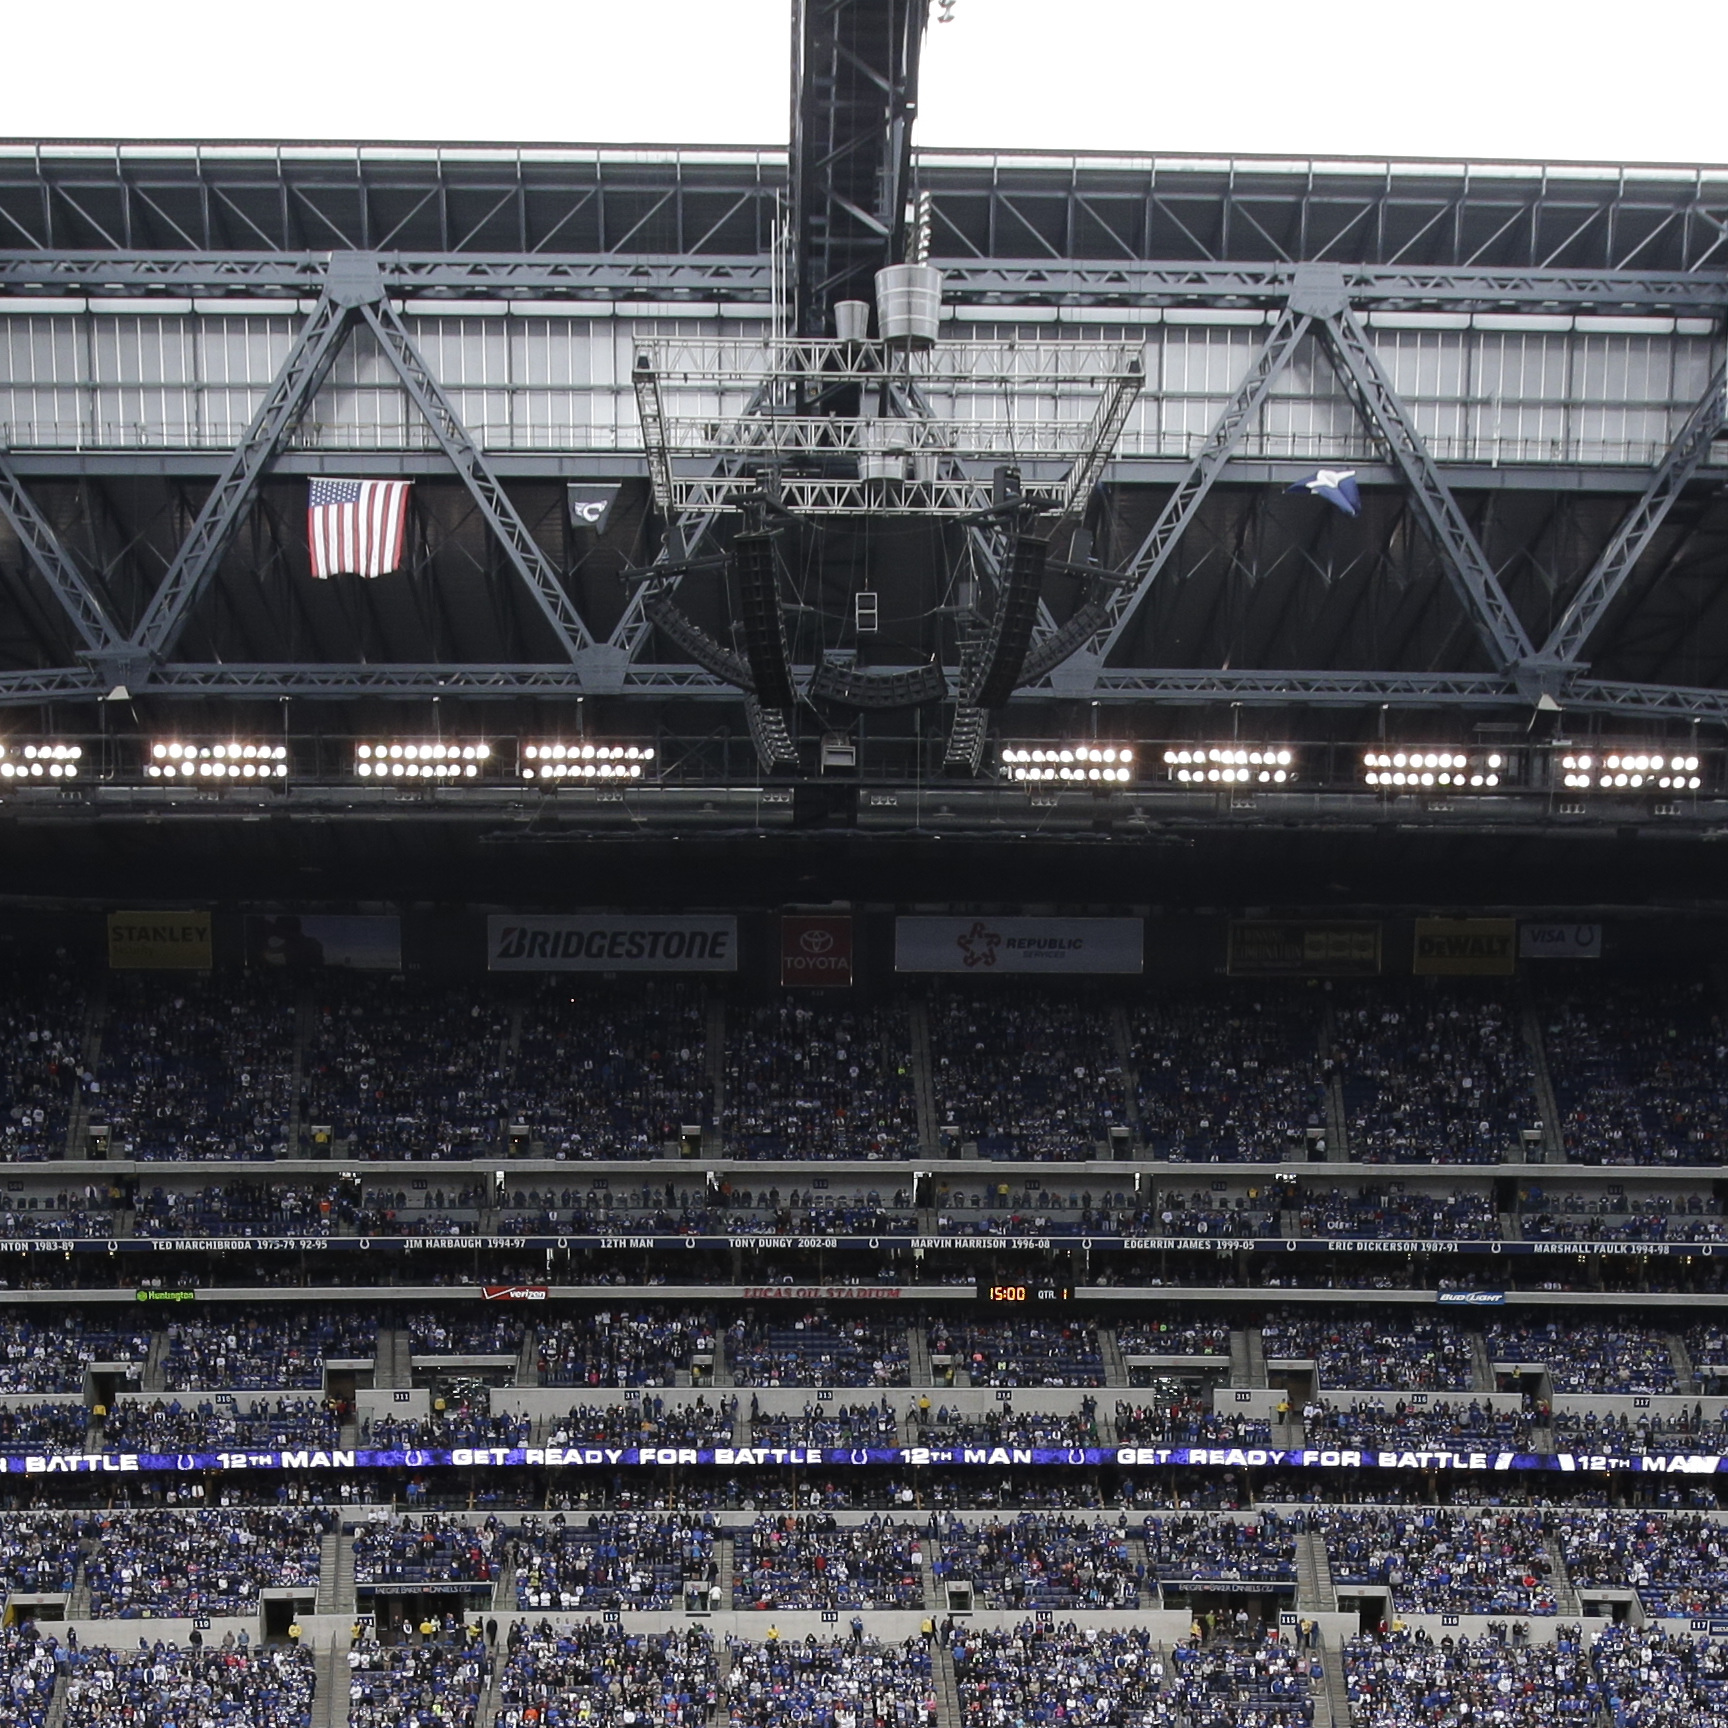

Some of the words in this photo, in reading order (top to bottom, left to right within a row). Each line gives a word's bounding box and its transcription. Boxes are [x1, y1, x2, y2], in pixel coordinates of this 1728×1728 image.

[112, 925, 208, 943] STANLEY
[1530, 929, 1566, 943] VISA
[496, 927, 729, 959] BRIDGESTONE
[1006, 938, 1084, 950] REPUBLIC
[784, 956, 849, 970] TOYOTA
[152, 1240, 172, 1250] TED
[175, 1240, 251, 1250] MARCHIBRODA
[404, 1239, 422, 1248] JIM
[425, 1239, 481, 1248] HARBAUGH
[629, 1239, 654, 1248] MAN
[729, 1239, 755, 1249] TONY
[758, 1239, 792, 1249] DUNGY
[911, 1239, 950, 1249] MARVIN
[954, 1239, 1006, 1249] HARRISON
[1124, 1240, 1175, 1250] EDGERRIN
[1178, 1240, 1211, 1250] JAMES
[1328, 1241, 1352, 1251] ERIC
[1355, 1241, 1417, 1252] DICKERSON
[1534, 1243, 1591, 1254] MARSHALL
[1594, 1244, 1627, 1255] FAULK
[148, 1290, 195, 1302] Huntington
[510, 1289, 546, 1300] verizon
[743, 1287, 792, 1298] LUCAS
[795, 1287, 823, 1298] OIL
[826, 1287, 901, 1298] STADIUM
[989, 1286, 1026, 1301] 15:00
[26, 1452, 138, 1472] BATTLE
[217, 1453, 272, 1468] 12TH
[281, 1451, 354, 1468] MAN
[452, 1448, 511, 1465] GET
[526, 1448, 622, 1465] READY
[640, 1449, 696, 1464] FOR
[715, 1448, 821, 1464] BATTLE
[900, 1448, 951, 1464] 12TH
[965, 1448, 1031, 1464] MAN
[1118, 1448, 1171, 1464] GET
[1189, 1449, 1285, 1466] READY
[1303, 1451, 1360, 1466] FOR
[1379, 1452, 1486, 1469] BATTLE
[1578, 1456, 1629, 1471] 12TH
